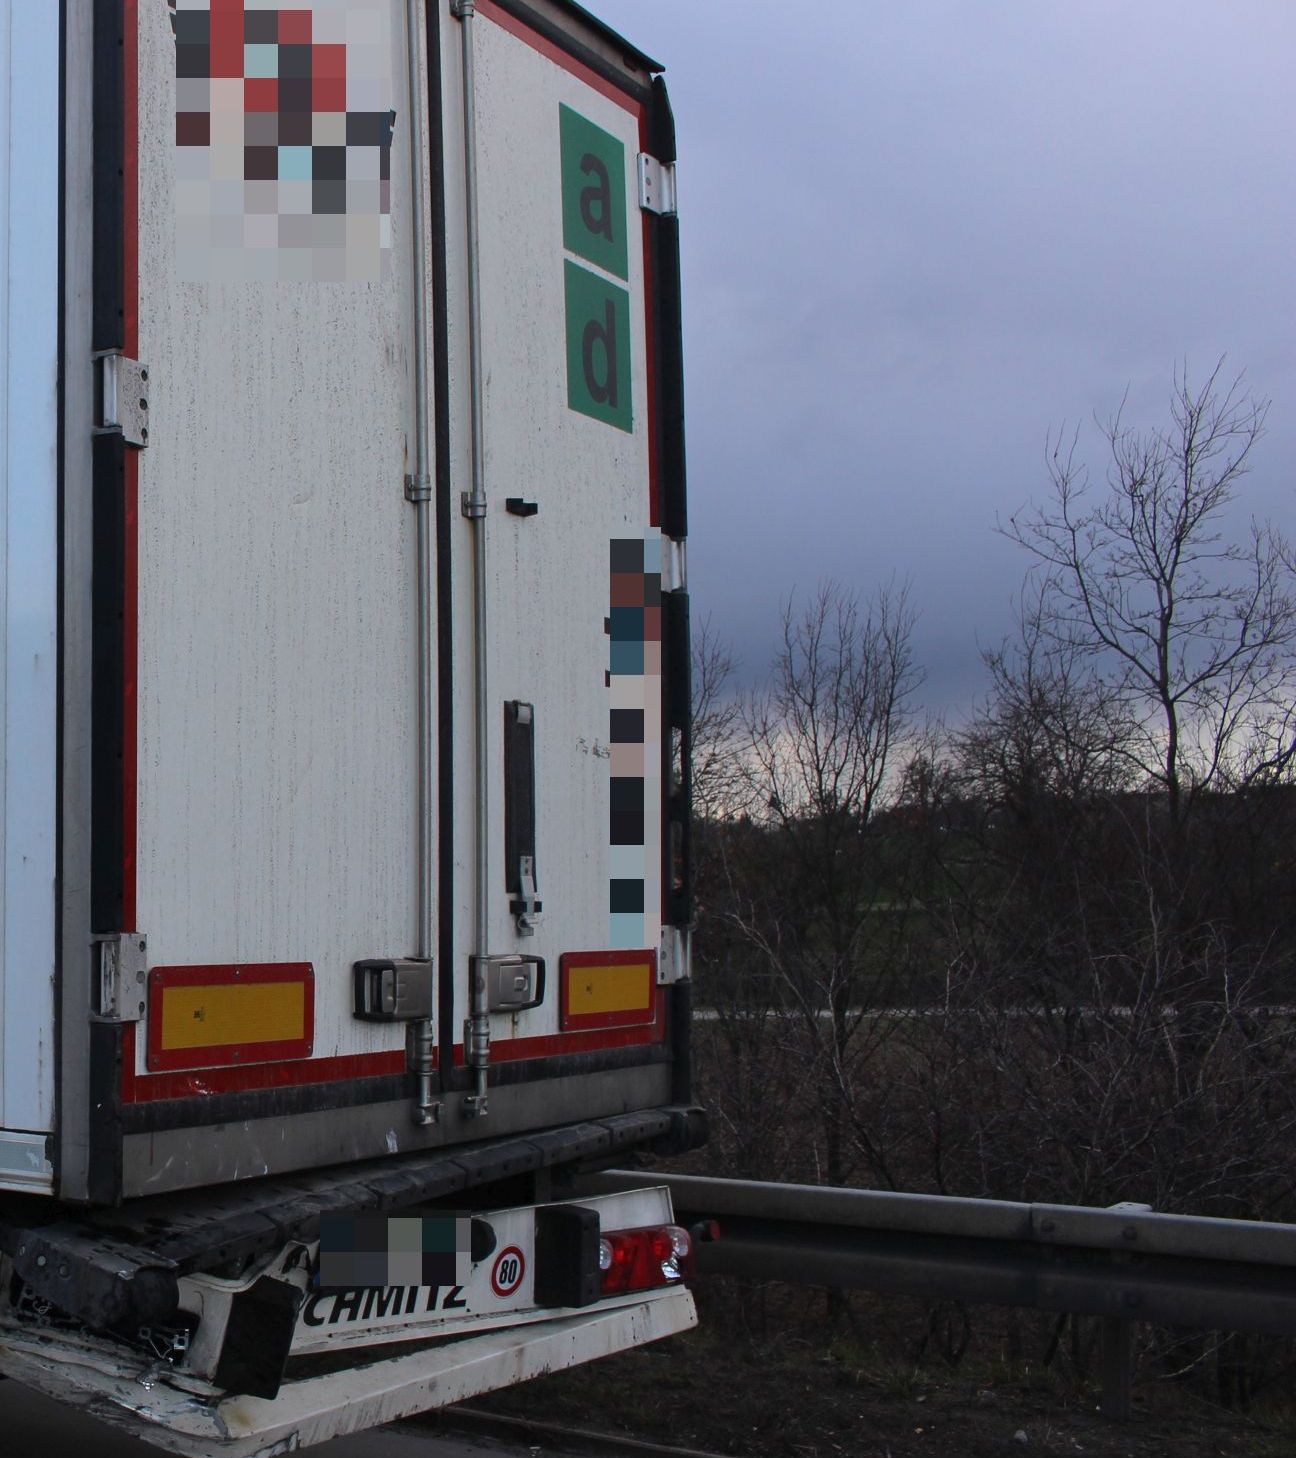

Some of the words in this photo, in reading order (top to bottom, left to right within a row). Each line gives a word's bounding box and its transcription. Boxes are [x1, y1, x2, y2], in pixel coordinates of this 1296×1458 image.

[579, 153, 613, 243] a
[582, 297, 618, 408] d
[499, 1259, 518, 1284] 80
[301, 1285, 467, 1327] CHMITZ
